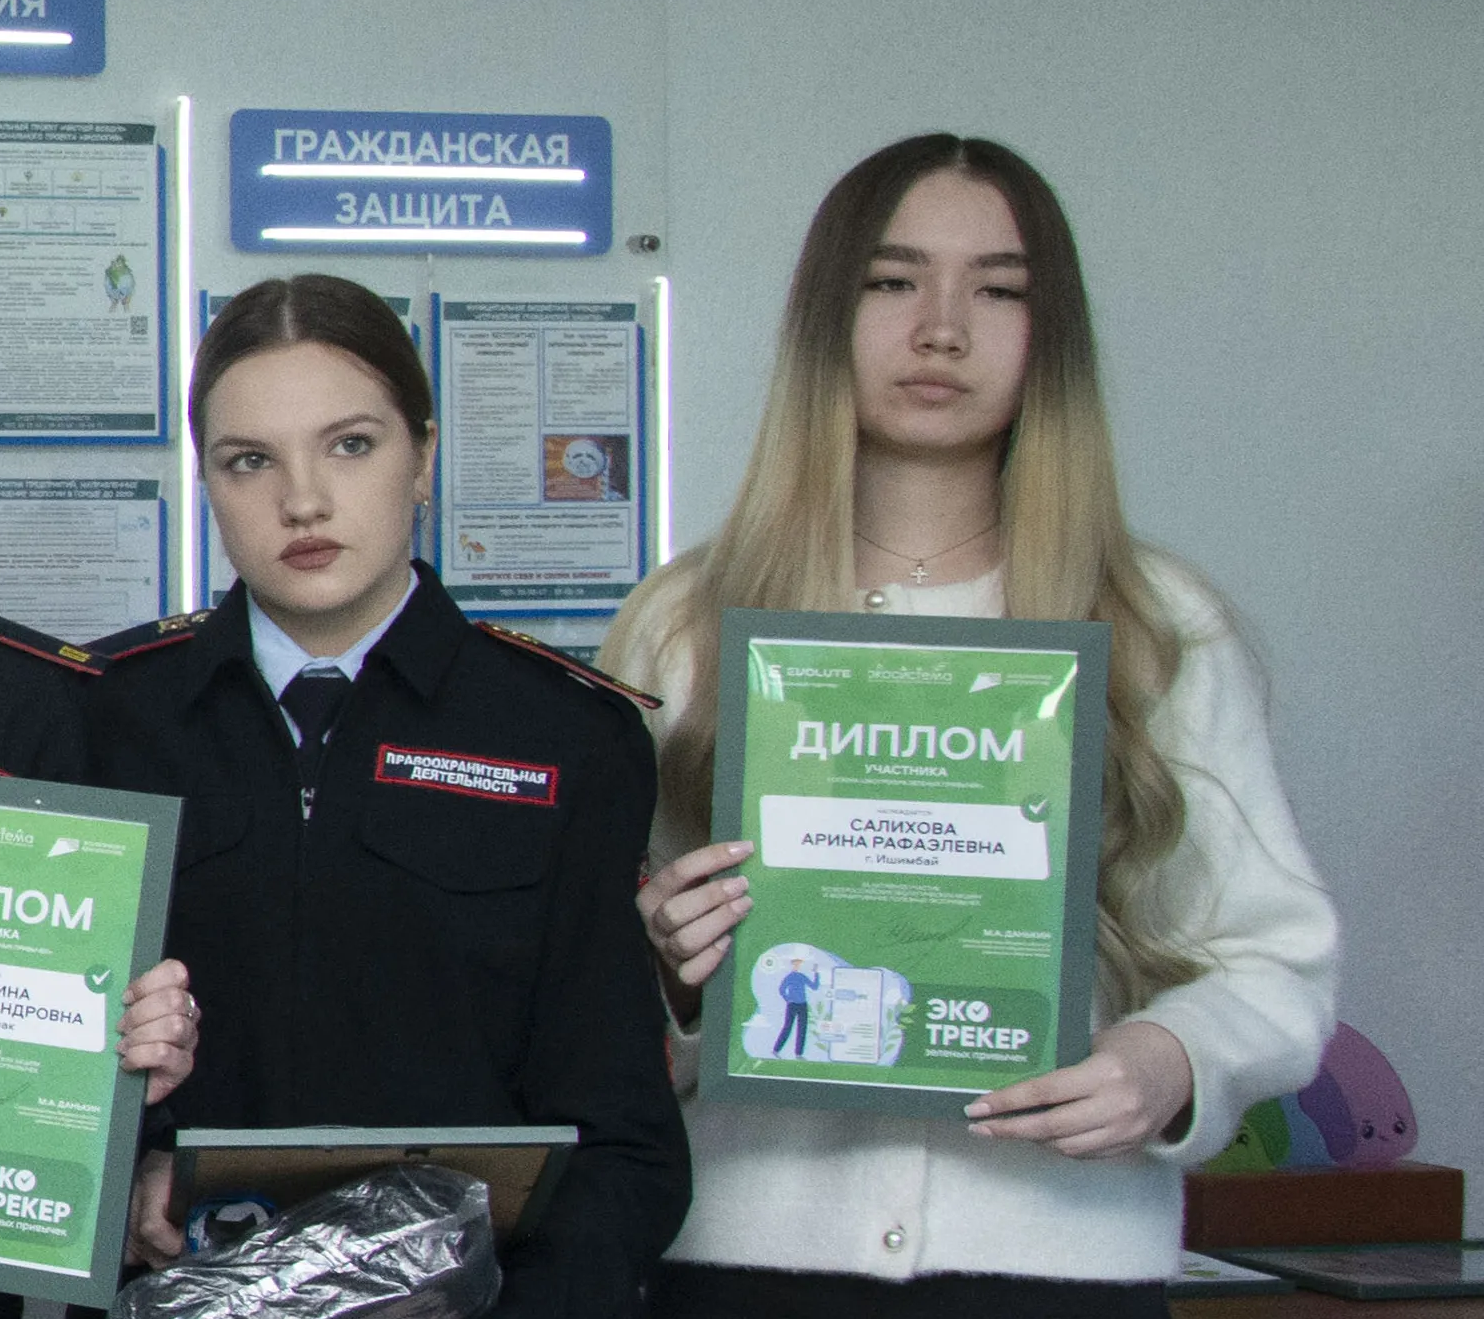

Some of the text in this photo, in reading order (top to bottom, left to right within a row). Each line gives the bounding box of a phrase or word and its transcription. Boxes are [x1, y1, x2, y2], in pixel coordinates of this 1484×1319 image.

[274, 129, 569, 166] ГРАЖДАНСКАЯ
[335, 193, 511, 228] ЗАЩИТА
[789, 720, 1024, 763] ДИПЛОМ
[385, 752, 547, 784] ПРАВООХРАНИТЕЛЬНАЯ
[410, 766, 518, 794] ДЕЯТЕЛЬНОСТЬ
[864, 763, 947, 777] УЧАСТНИКА
[850, 818, 957, 836] САЛИХОВА
[801, 832, 1005, 856] АРИНА РАФАЭЛЕВНА
[876, 854, 939, 867] Ишимбай
[927, 998, 991, 1022] ЭКО
[925, 1023, 1030, 1050] ТРЕКЕР
